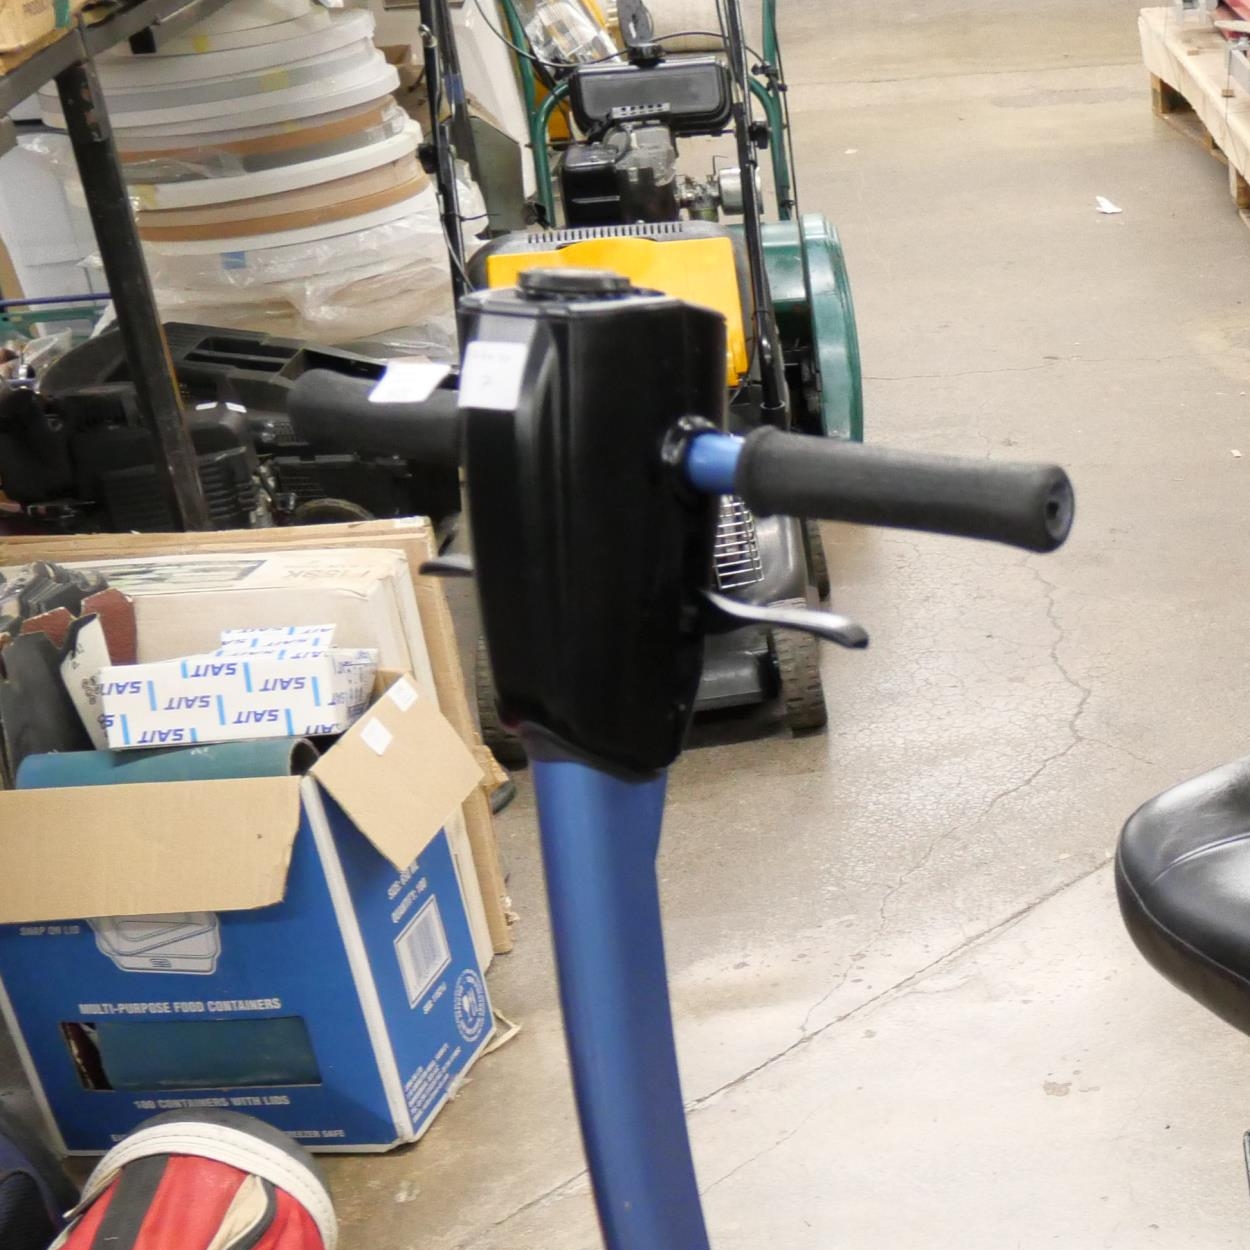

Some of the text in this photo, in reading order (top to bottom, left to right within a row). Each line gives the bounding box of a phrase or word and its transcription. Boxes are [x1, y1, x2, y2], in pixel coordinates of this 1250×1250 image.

[190, 662, 238, 678] SAIT
[258, 677, 307, 692] SAIT
[163, 695, 211, 711] SAIT
[231, 709, 280, 724] SAIT
[137, 728, 185, 744] SAIT
[78, 998, 282, 1015] MULTI-PURPOSE FOOD CONTAINERS
[263, 1095, 290, 1105] LIDS
